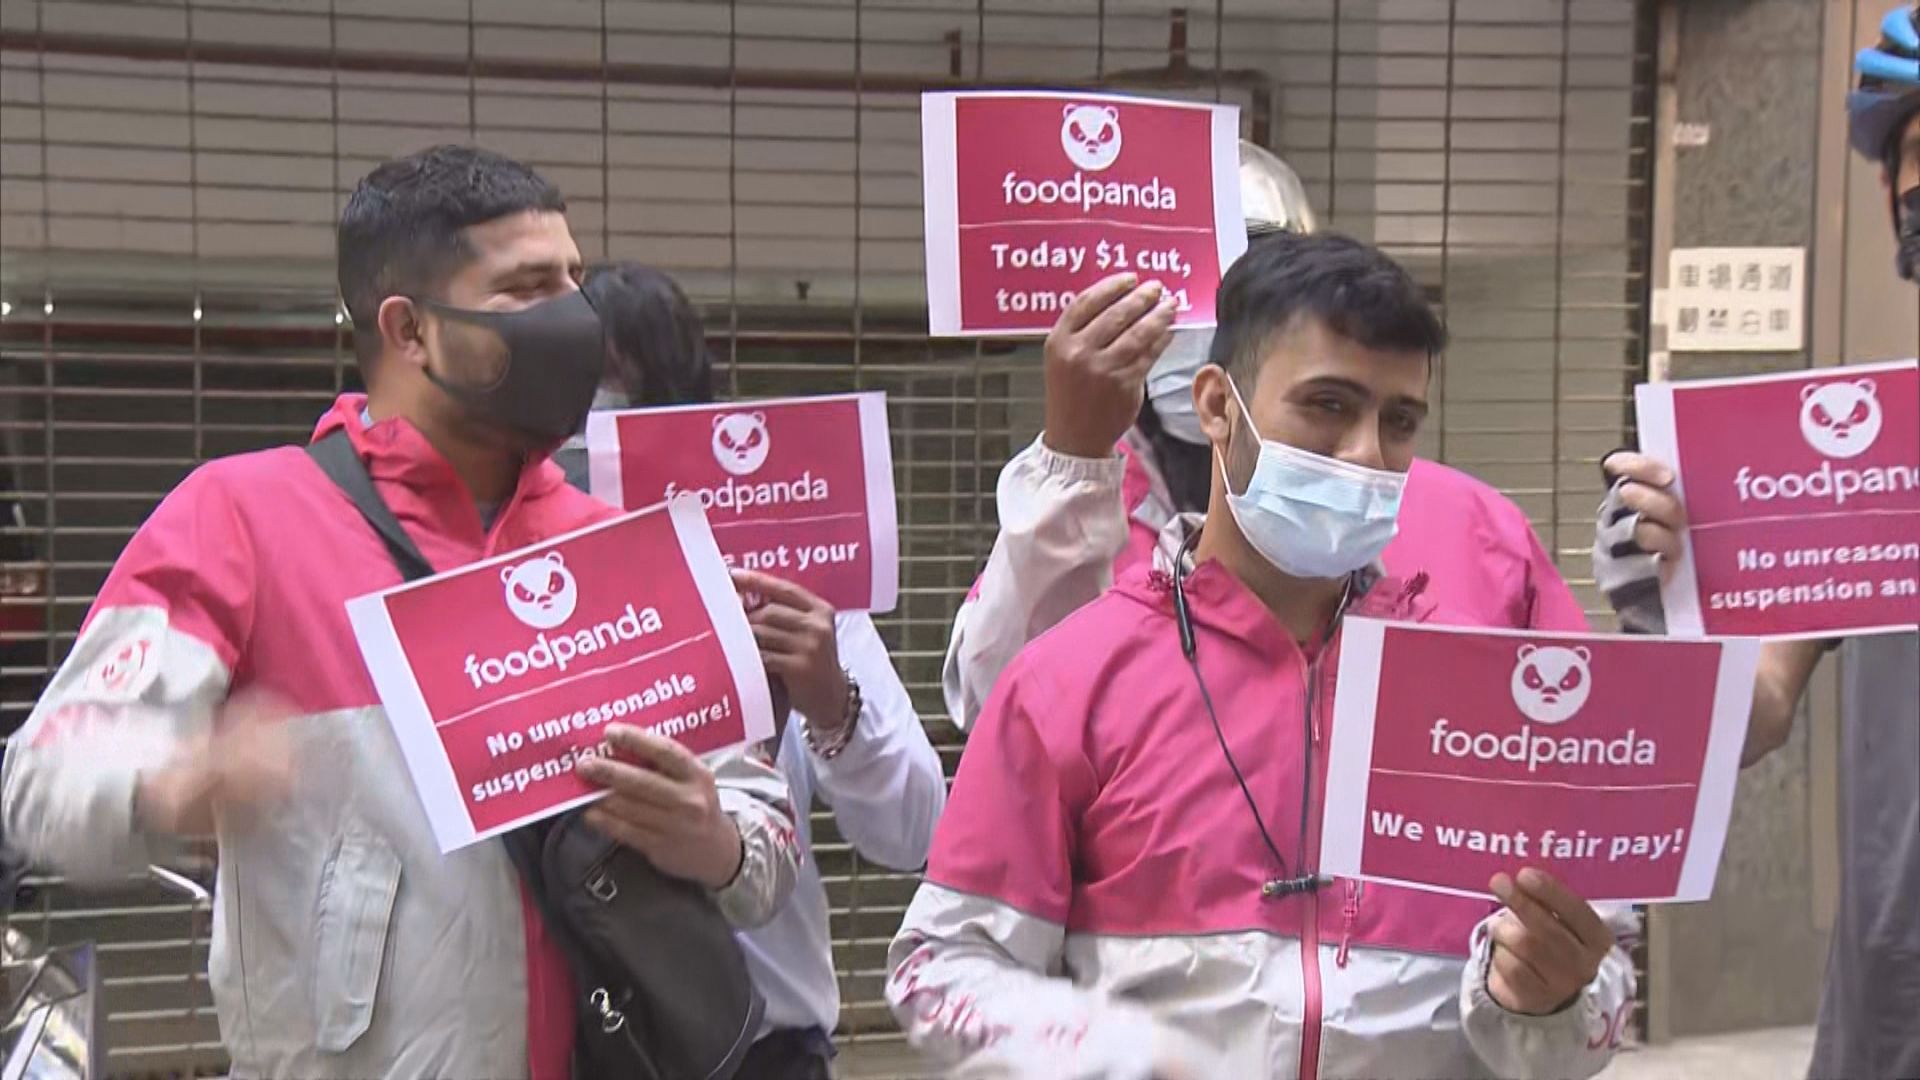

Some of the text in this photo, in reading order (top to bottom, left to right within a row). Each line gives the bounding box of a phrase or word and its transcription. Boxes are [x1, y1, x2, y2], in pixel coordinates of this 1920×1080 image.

[1002, 172, 1177, 212] foodpanda
[991, 240, 1191, 278] Today $1 cut,
[743, 545, 790, 569] not
[795, 541, 859, 570] your
[1737, 543, 1919, 571] No unreason
[1710, 577, 1916, 611] suspension an
[464, 603, 663, 689] foodpanda
[486, 673, 697, 758] No unreasonable
[647, 694, 732, 738] ymore!
[1429, 718, 1657, 772] foodpanda
[1371, 810, 1685, 861] We want fair pay!
